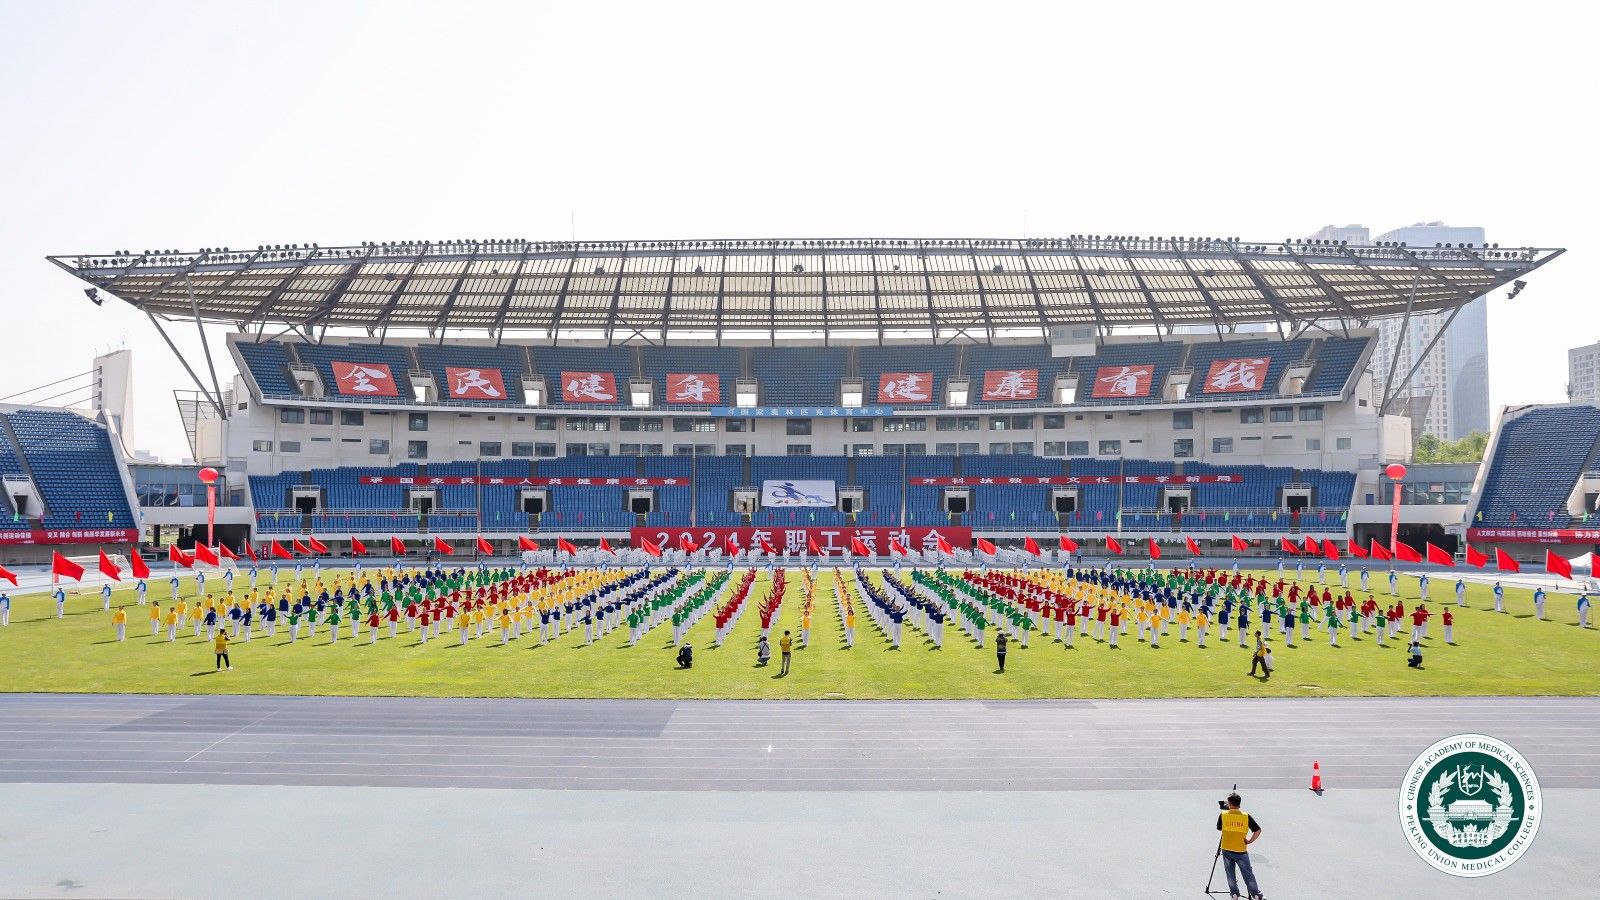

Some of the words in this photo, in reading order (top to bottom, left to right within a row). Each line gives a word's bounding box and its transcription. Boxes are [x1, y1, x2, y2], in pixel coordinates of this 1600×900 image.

[341, 364, 387, 393] 全
[455, 369, 501, 397] 民
[567, 373, 614, 400] 健
[674, 374, 709, 402] 身
[883, 373, 924, 401] 健
[987, 370, 1032, 399] 康
[1100, 366, 1148, 396] 有
[1213, 359, 1264, 390] 我
[740, 408, 884, 416] 国家奥林匹克体育中心
